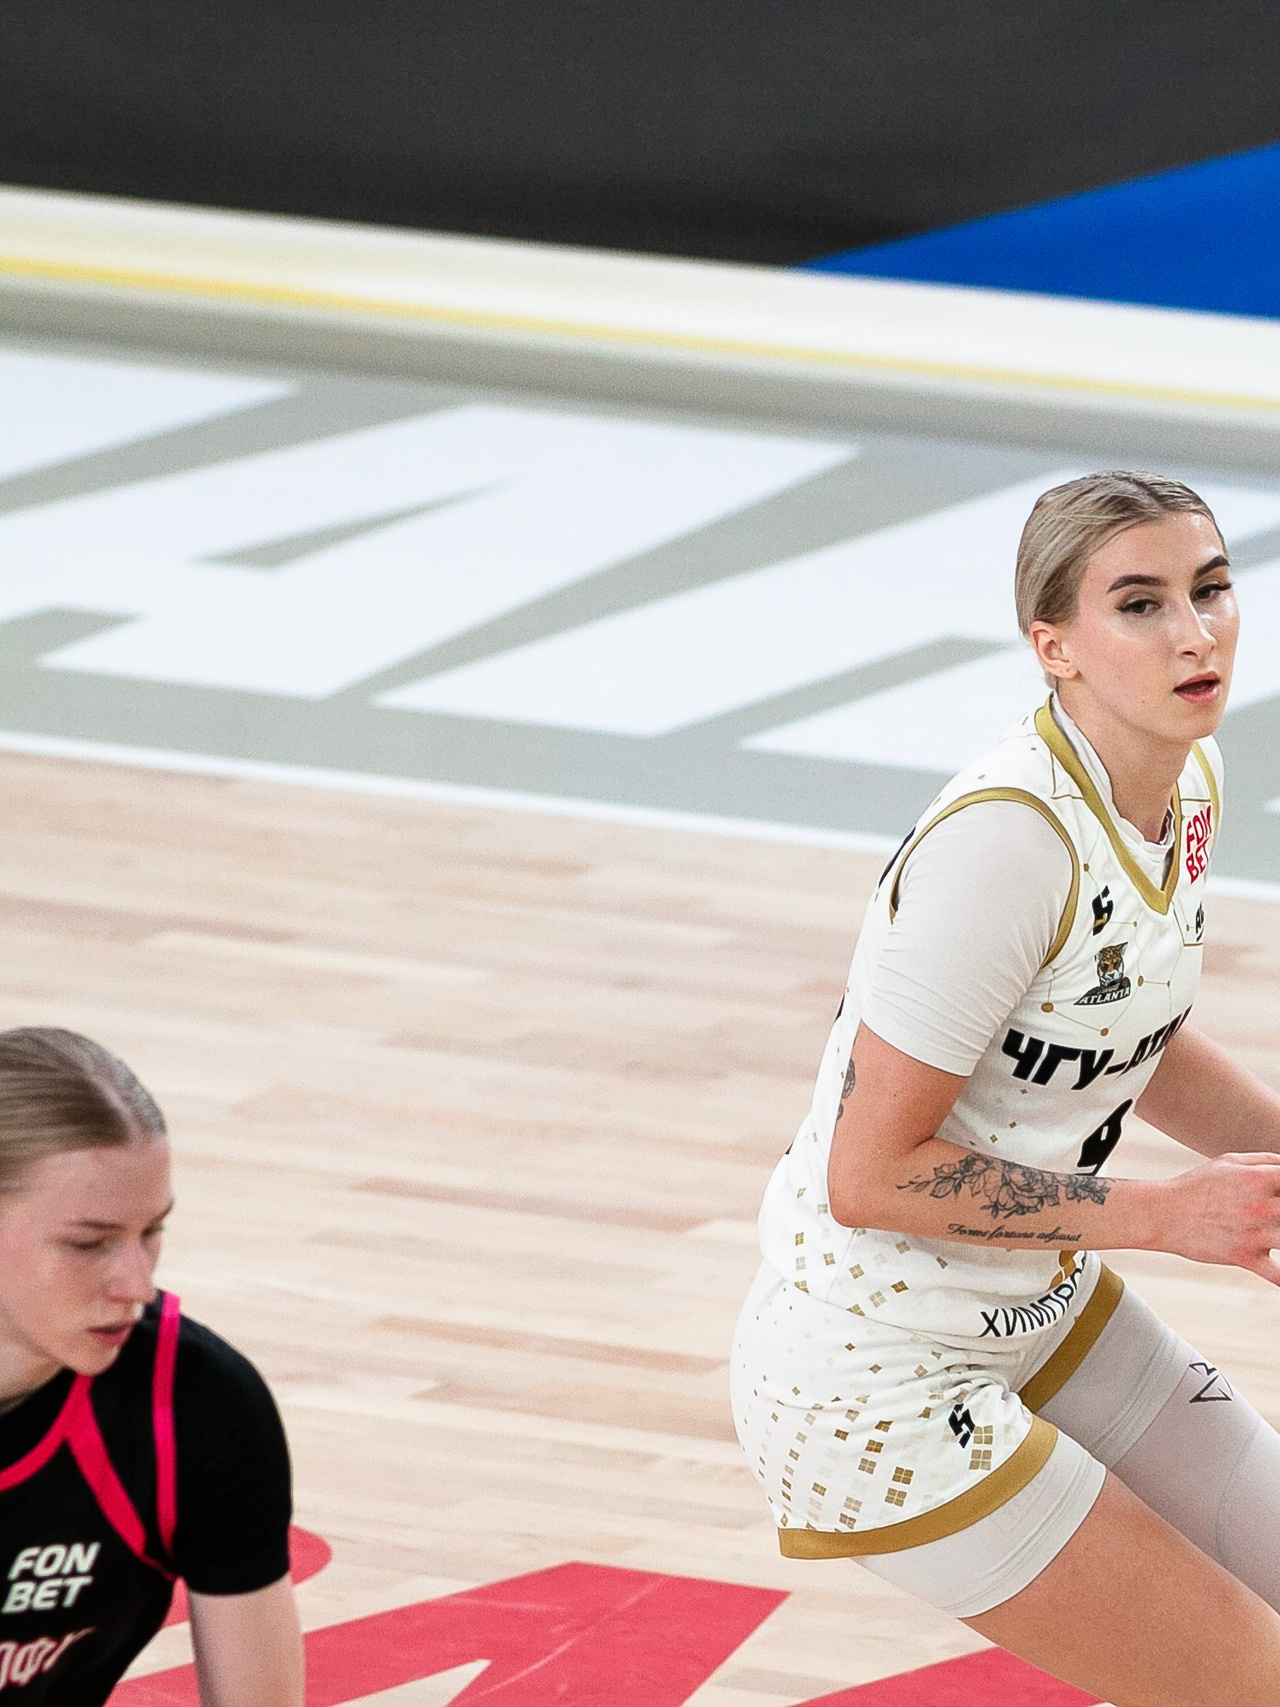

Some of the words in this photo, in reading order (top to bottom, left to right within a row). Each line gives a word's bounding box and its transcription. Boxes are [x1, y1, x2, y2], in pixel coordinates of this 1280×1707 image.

[1077, 986, 1131, 1004] ATLANTA
[7, 1541, 101, 1581] FON
[0, 1575, 94, 1615] BET
